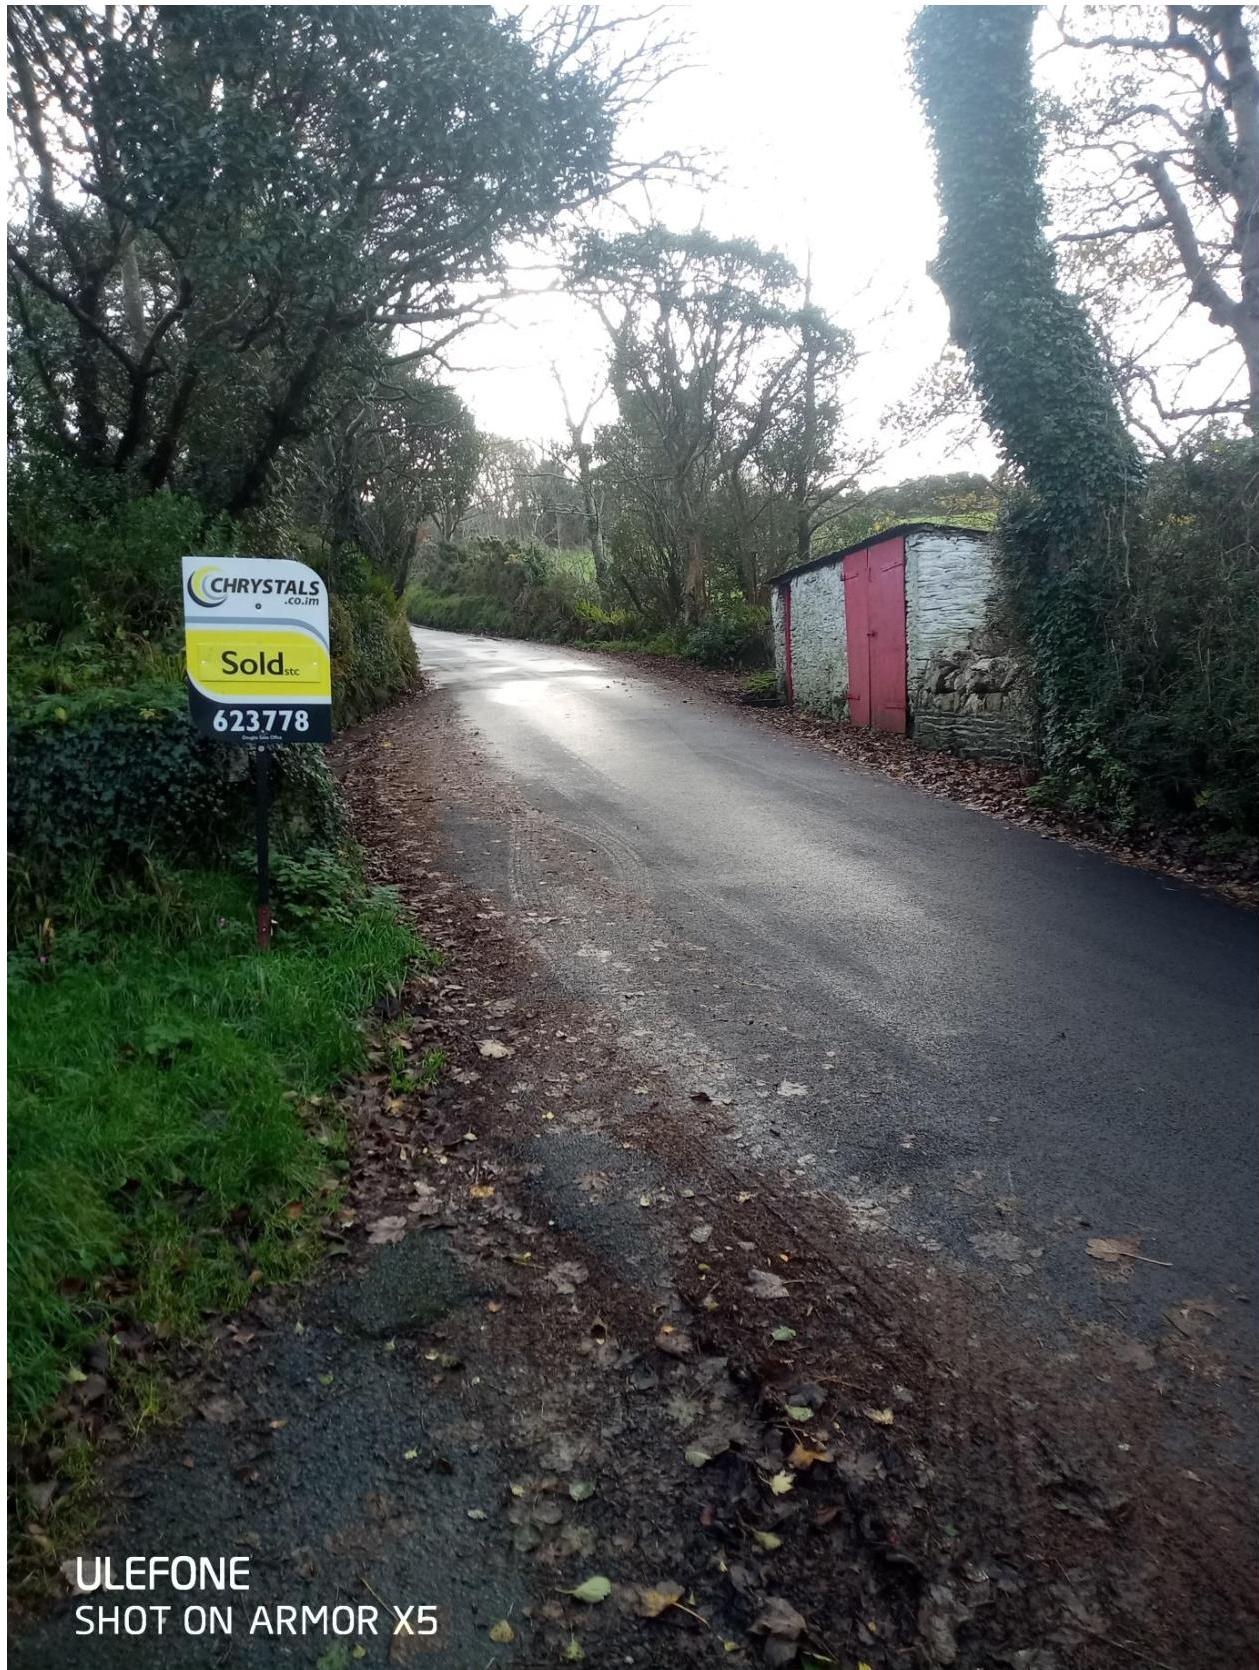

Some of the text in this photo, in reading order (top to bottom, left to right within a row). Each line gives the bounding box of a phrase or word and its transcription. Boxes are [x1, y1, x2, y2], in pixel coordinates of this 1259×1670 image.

[210, 577, 320, 596] CHRYSTALS
[284, 596, 320, 606] .co.im
[221, 650, 300, 676] Sold stc
[213, 709, 310, 732] 623778
